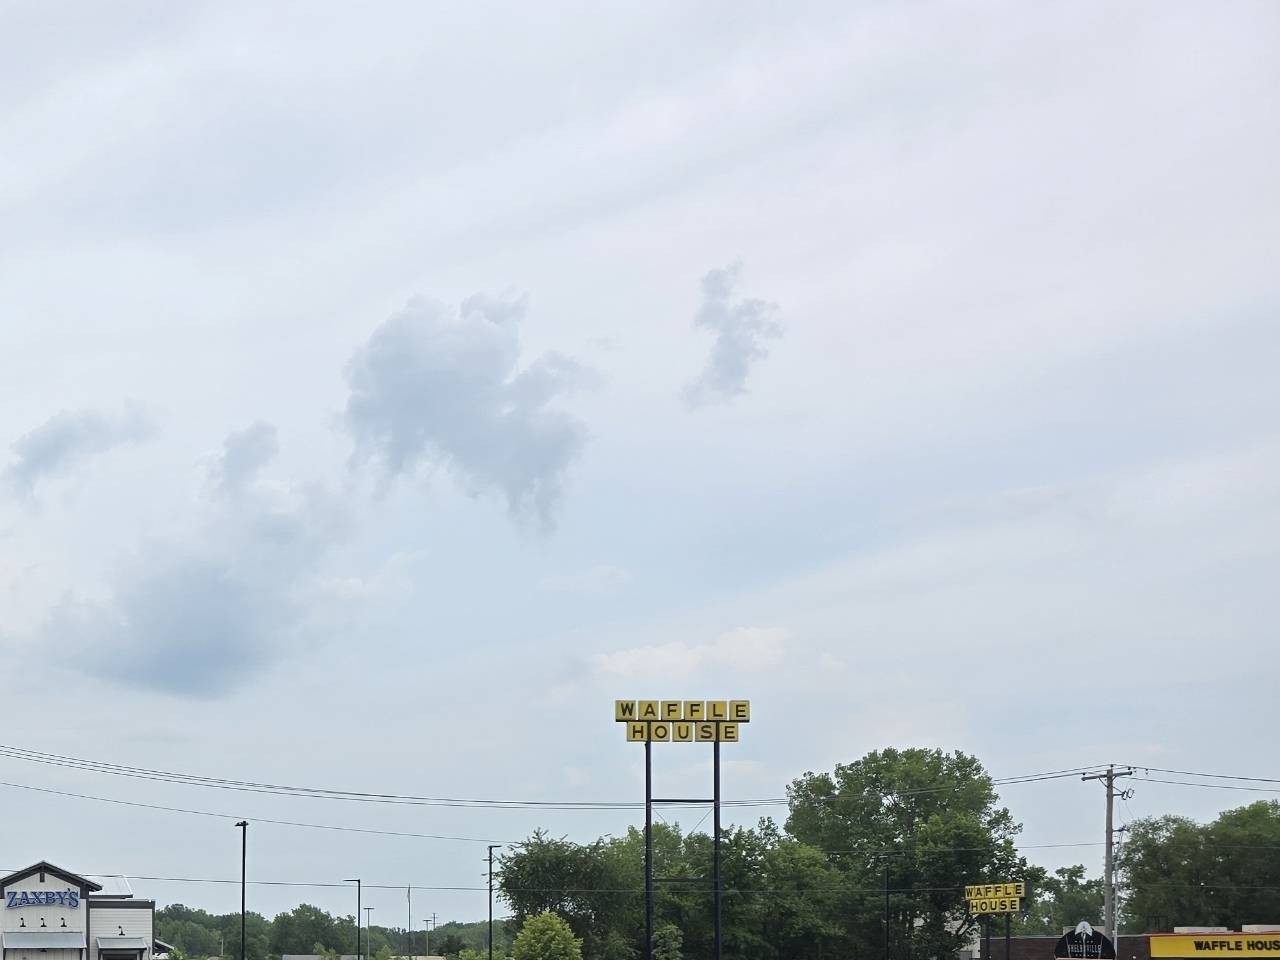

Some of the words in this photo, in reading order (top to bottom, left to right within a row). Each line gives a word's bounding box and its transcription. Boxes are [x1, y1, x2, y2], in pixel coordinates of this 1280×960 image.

[620, 702, 747, 718] WAFFLE
[632, 724, 736, 739] HOUSE
[6, 887, 79, 908] ZAXBY'S
[965, 884, 1022, 897] WAFFLE
[971, 900, 1017, 911] HOUSE
[1193, 940, 1243, 951] WAFFLE
